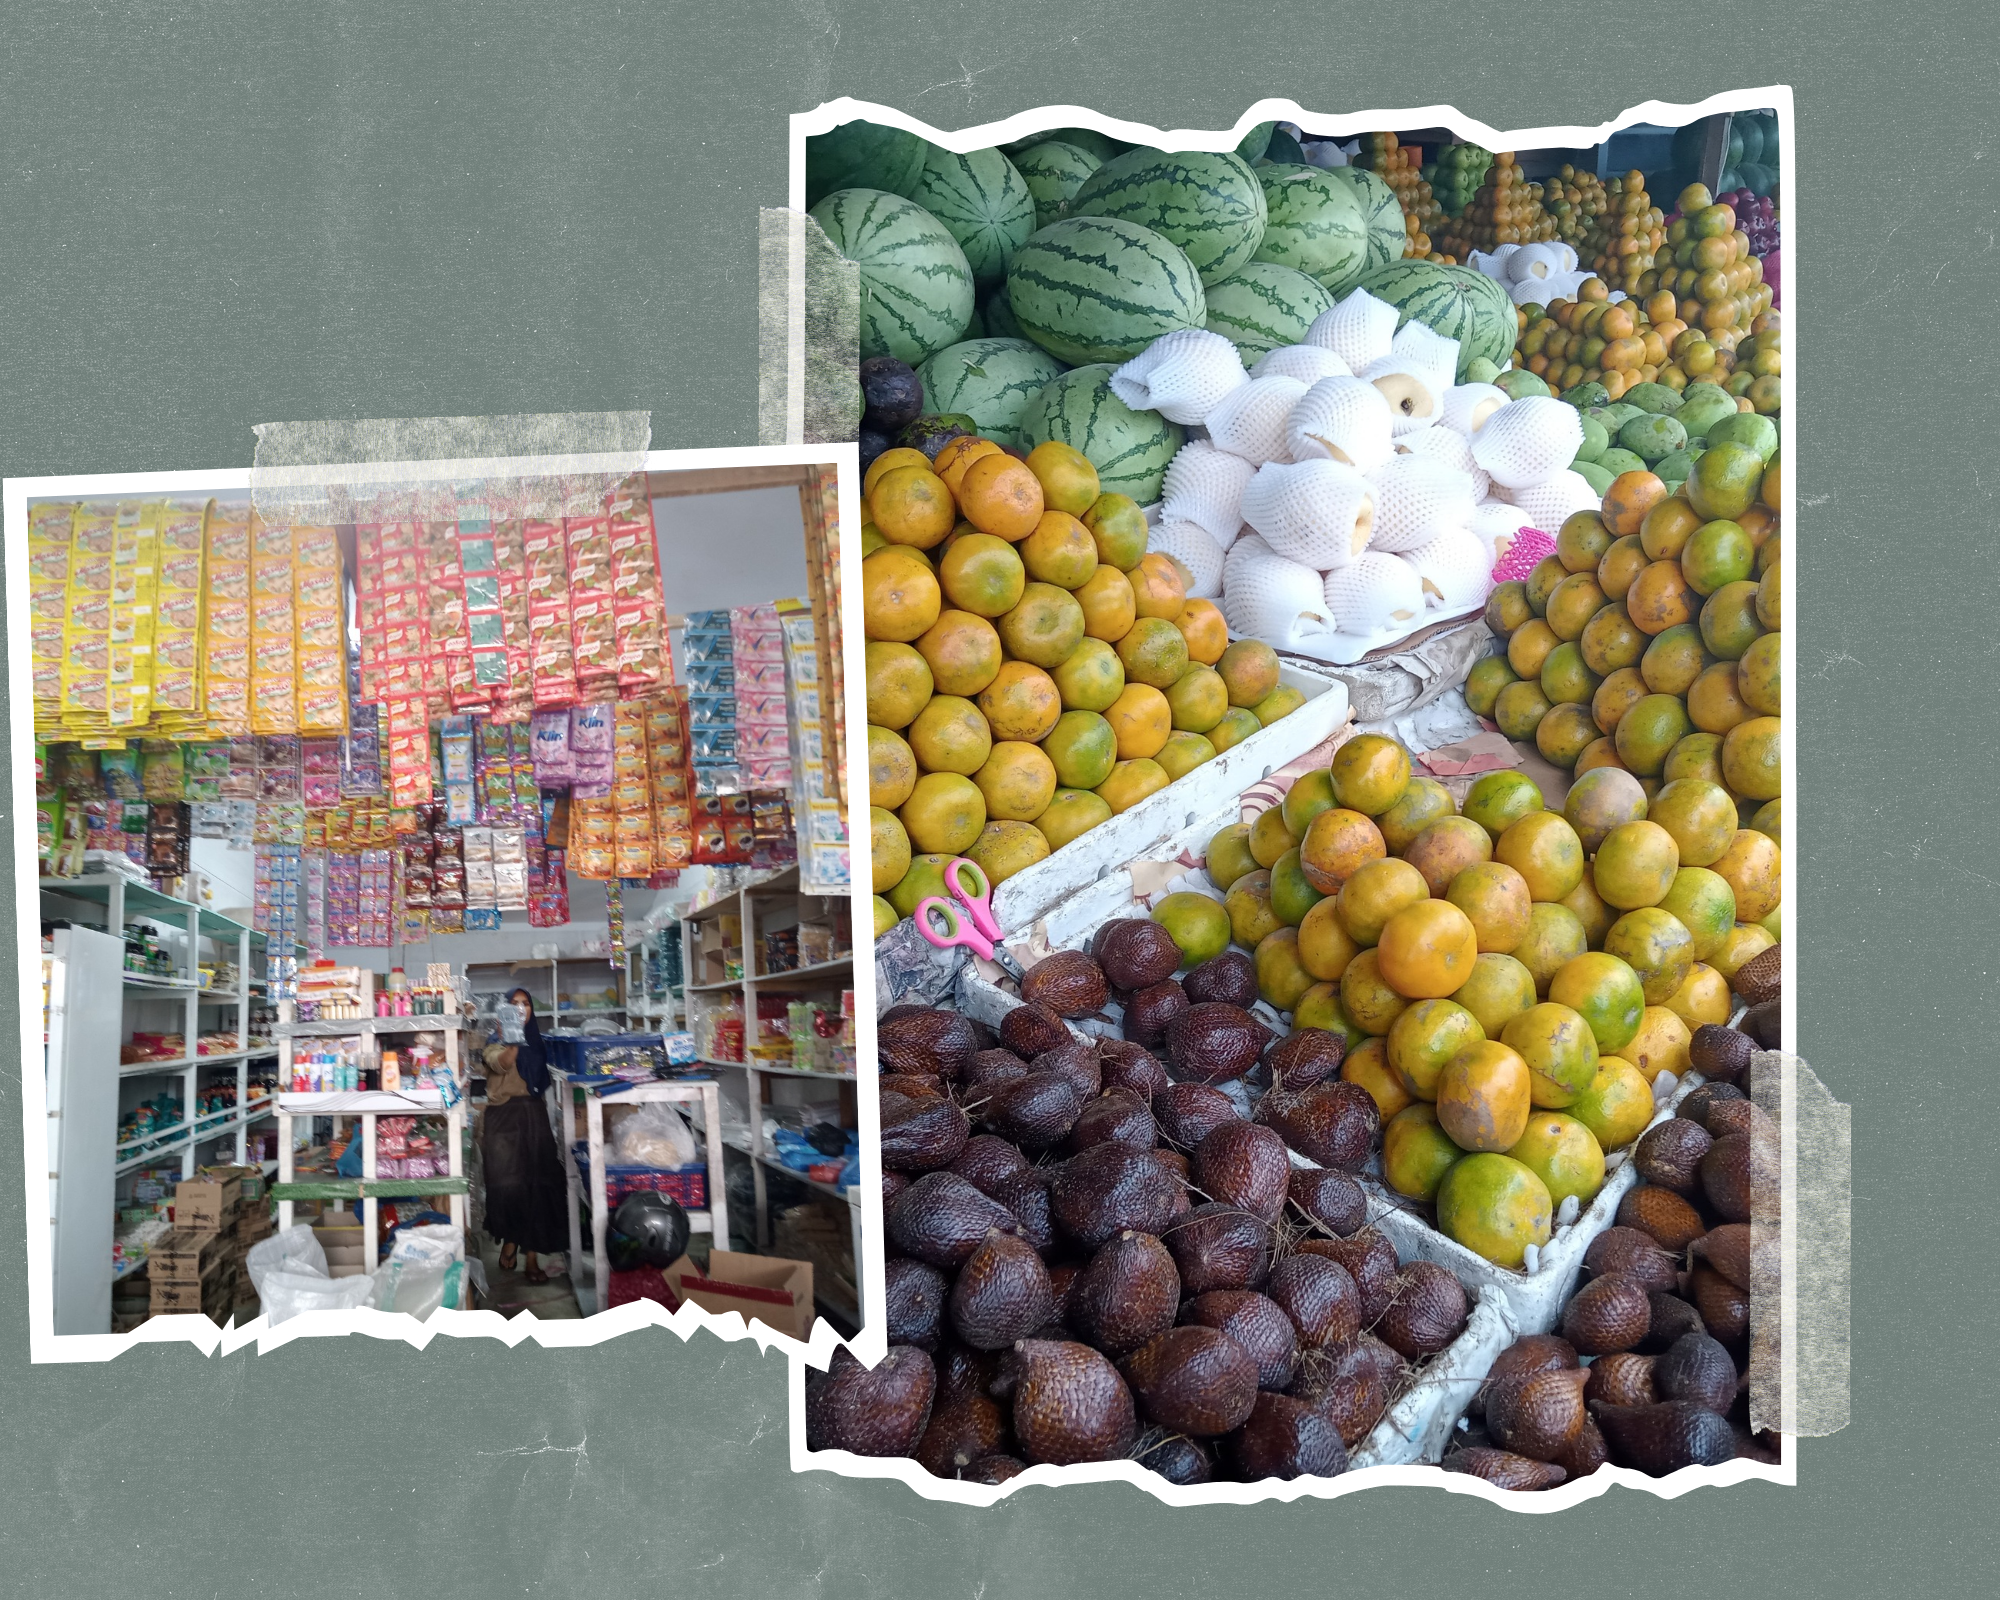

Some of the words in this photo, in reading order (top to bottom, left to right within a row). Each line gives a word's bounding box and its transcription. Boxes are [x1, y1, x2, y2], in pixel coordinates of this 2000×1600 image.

[612, 502, 631, 512] Royco
[572, 530, 590, 540] Royco
[528, 539, 547, 550] Royco
[614, 538, 634, 548] Royco
[574, 568, 593, 578] Royco
[530, 578, 550, 588] Royco
[616, 576, 636, 586] Royco
[576, 606, 596, 616] Royco
[532, 616, 552, 628] Royco
[618, 614, 639, 624] Royco
[578, 644, 598, 654] Royco
[536, 654, 556, 664] Royco
[620, 652, 642, 662] Royco
[578, 716, 604, 729] Klin
[537, 730, 564, 742] Klin
